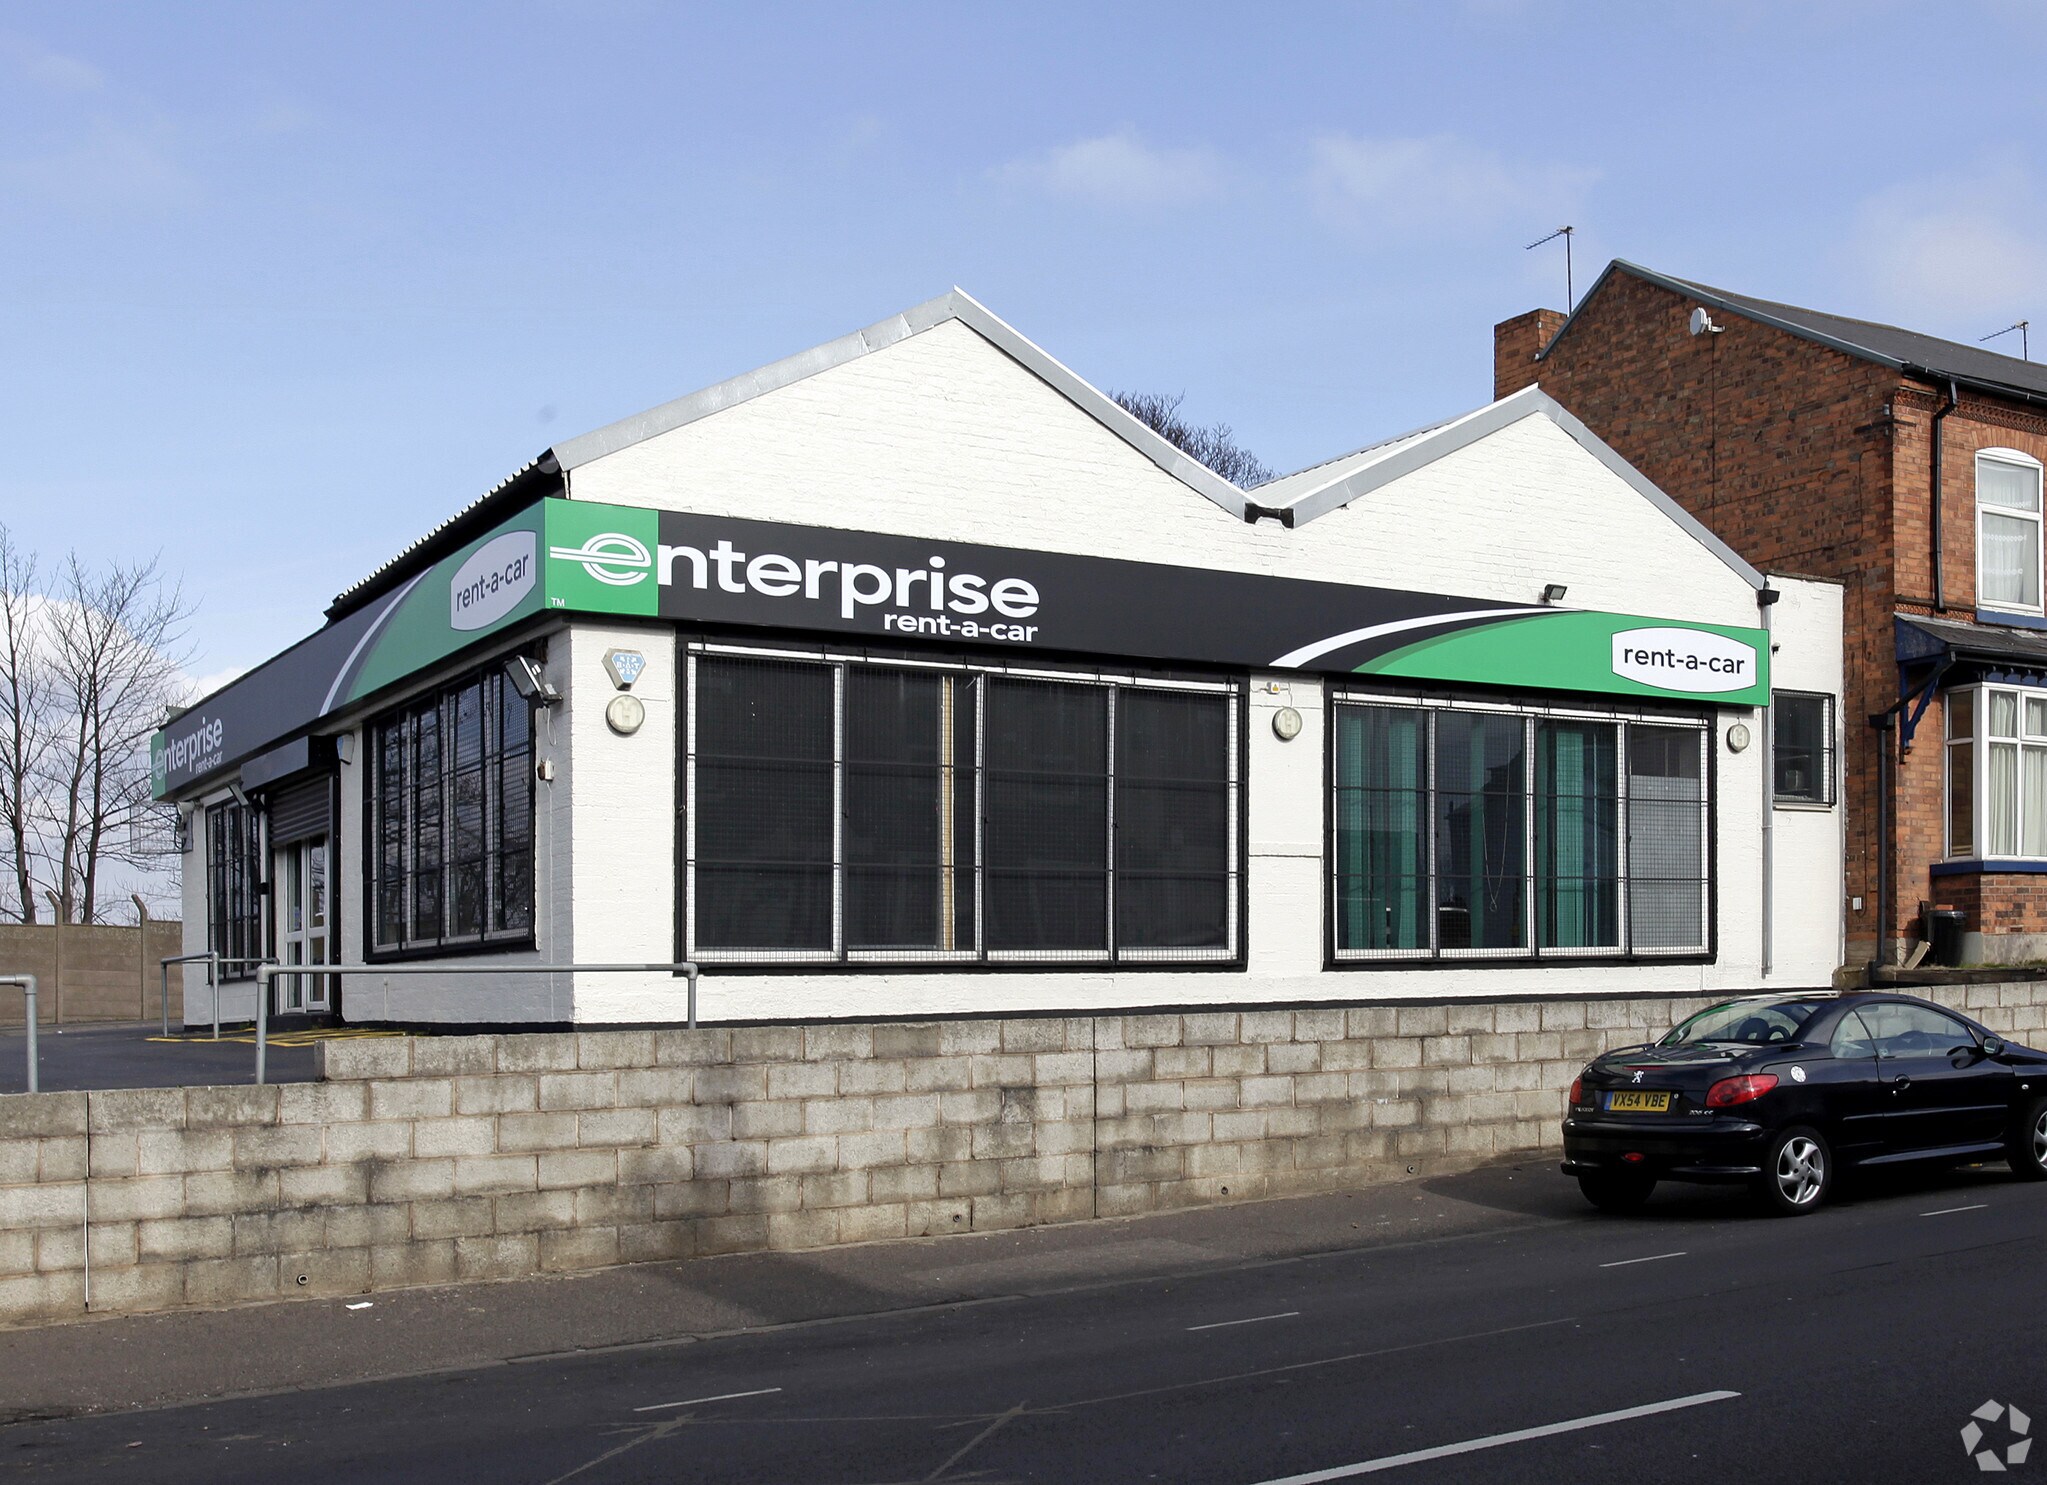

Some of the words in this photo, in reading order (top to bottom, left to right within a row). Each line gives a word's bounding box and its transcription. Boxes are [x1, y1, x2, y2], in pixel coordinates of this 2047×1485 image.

[456, 552, 529, 612] rent-a-car
[550, 532, 1040, 619] enterprise
[550, 597, 566, 608] TM
[884, 612, 1039, 643] rent-a-car
[1624, 648, 1745, 675] rent-a-car
[152, 716, 223, 780] enterprise
[195, 750, 223, 775] rent-a-car
[1613, 1093, 1641, 1107] VX54
[1644, 1093, 1667, 1108] VBE
